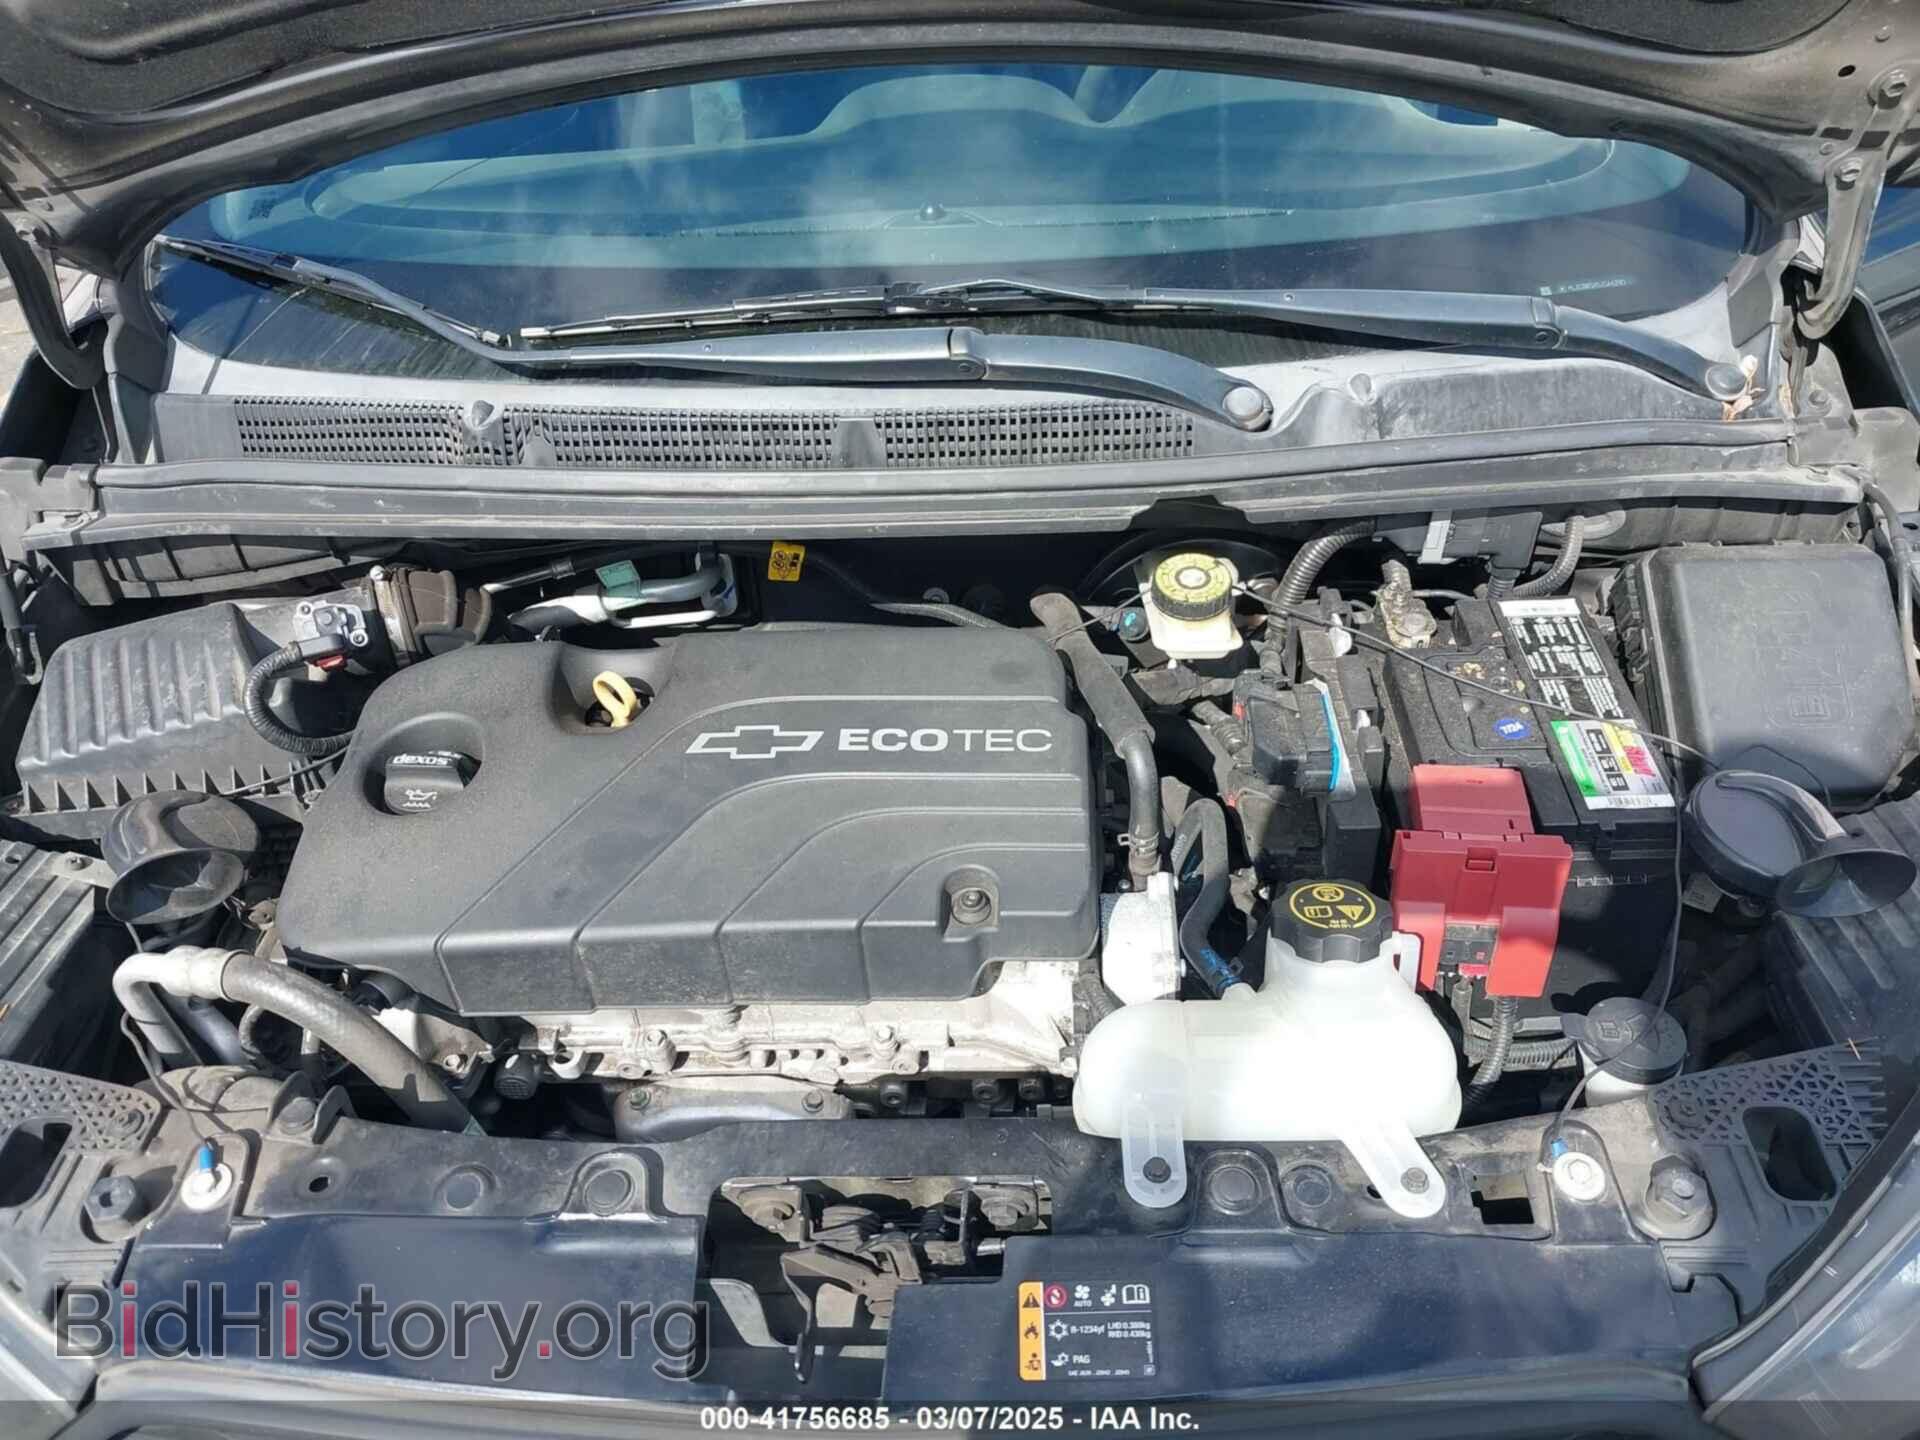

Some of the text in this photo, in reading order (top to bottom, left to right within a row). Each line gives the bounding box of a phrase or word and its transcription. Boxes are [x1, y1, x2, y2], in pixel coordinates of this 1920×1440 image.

[838, 728, 1053, 752] ECOTEC
[392, 753, 452, 766] dexos
[1073, 1354, 1091, 1364] PAG
